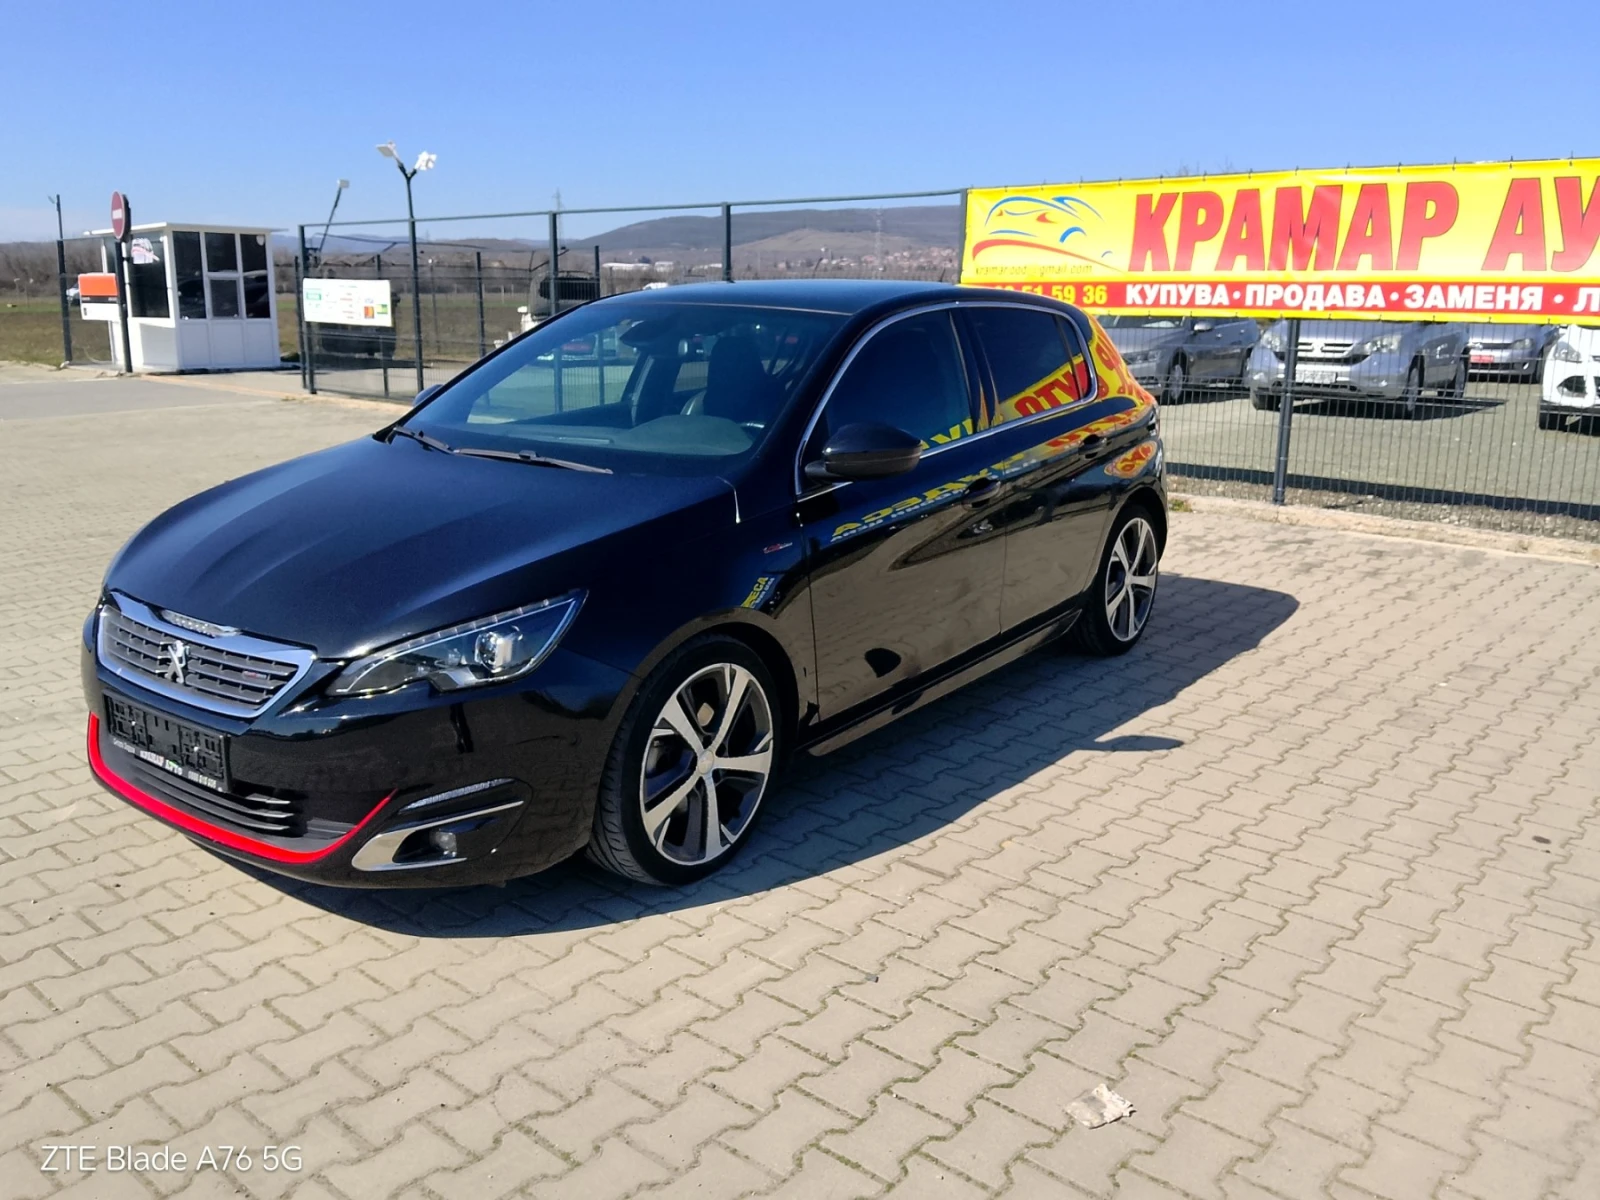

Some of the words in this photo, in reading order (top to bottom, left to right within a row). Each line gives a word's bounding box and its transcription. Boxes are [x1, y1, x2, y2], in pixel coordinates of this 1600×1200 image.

[1128, 181, 1459, 272] КРАМАР
[1082, 285, 1108, 305] 36
[1126, 284, 1230, 305] КУПУВА
[1245, 284, 1386, 311] ПРОДАВА
[1404, 284, 1544, 311] ЗАМЕНЯ
